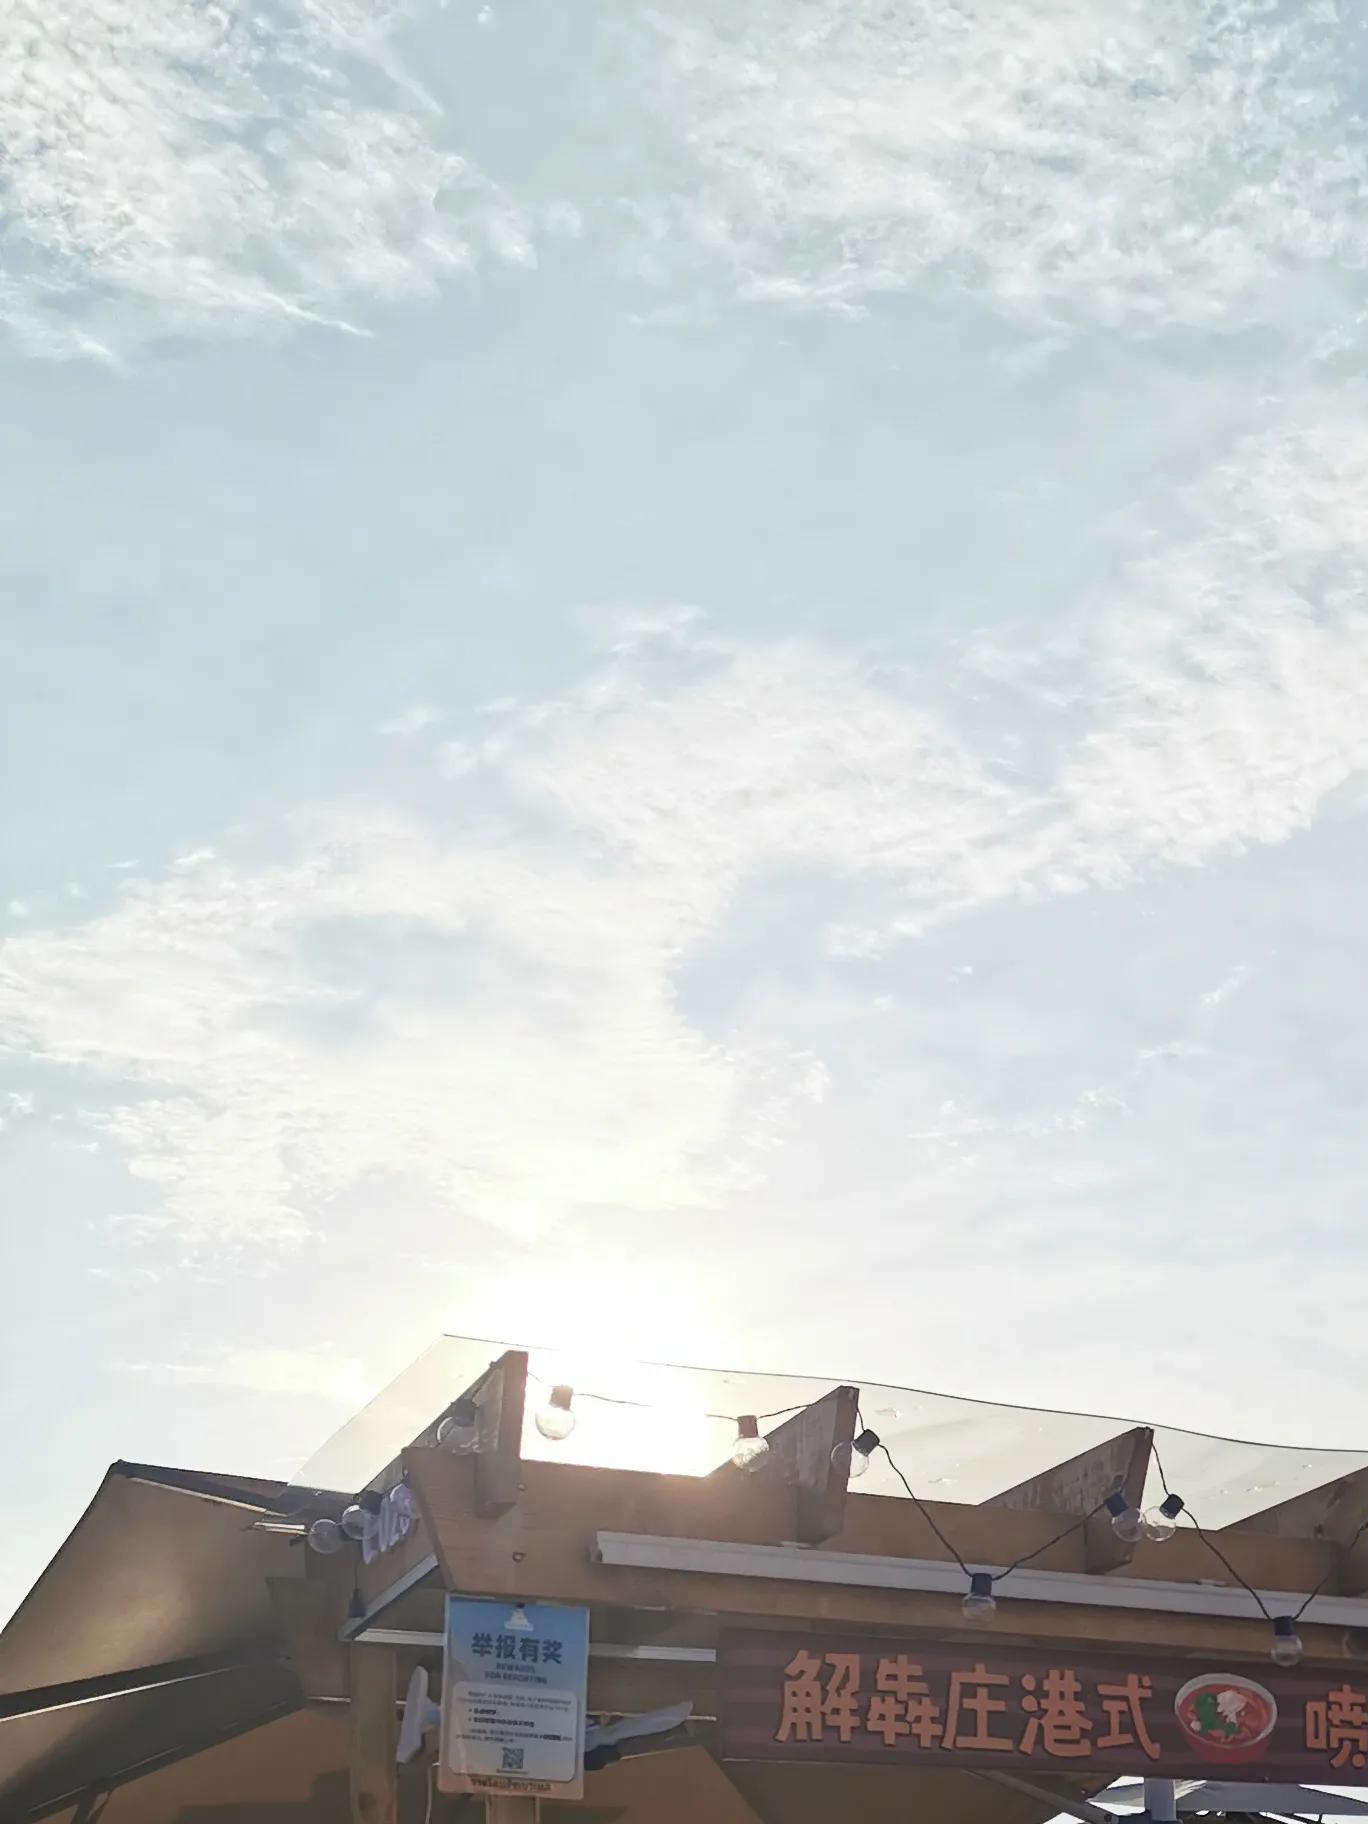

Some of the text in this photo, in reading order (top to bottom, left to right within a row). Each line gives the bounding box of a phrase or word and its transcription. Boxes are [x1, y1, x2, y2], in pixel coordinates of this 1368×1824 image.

[471, 1632, 563, 1665] 举报有奖
[775, 1650, 1162, 1759] 解犇庄港式
